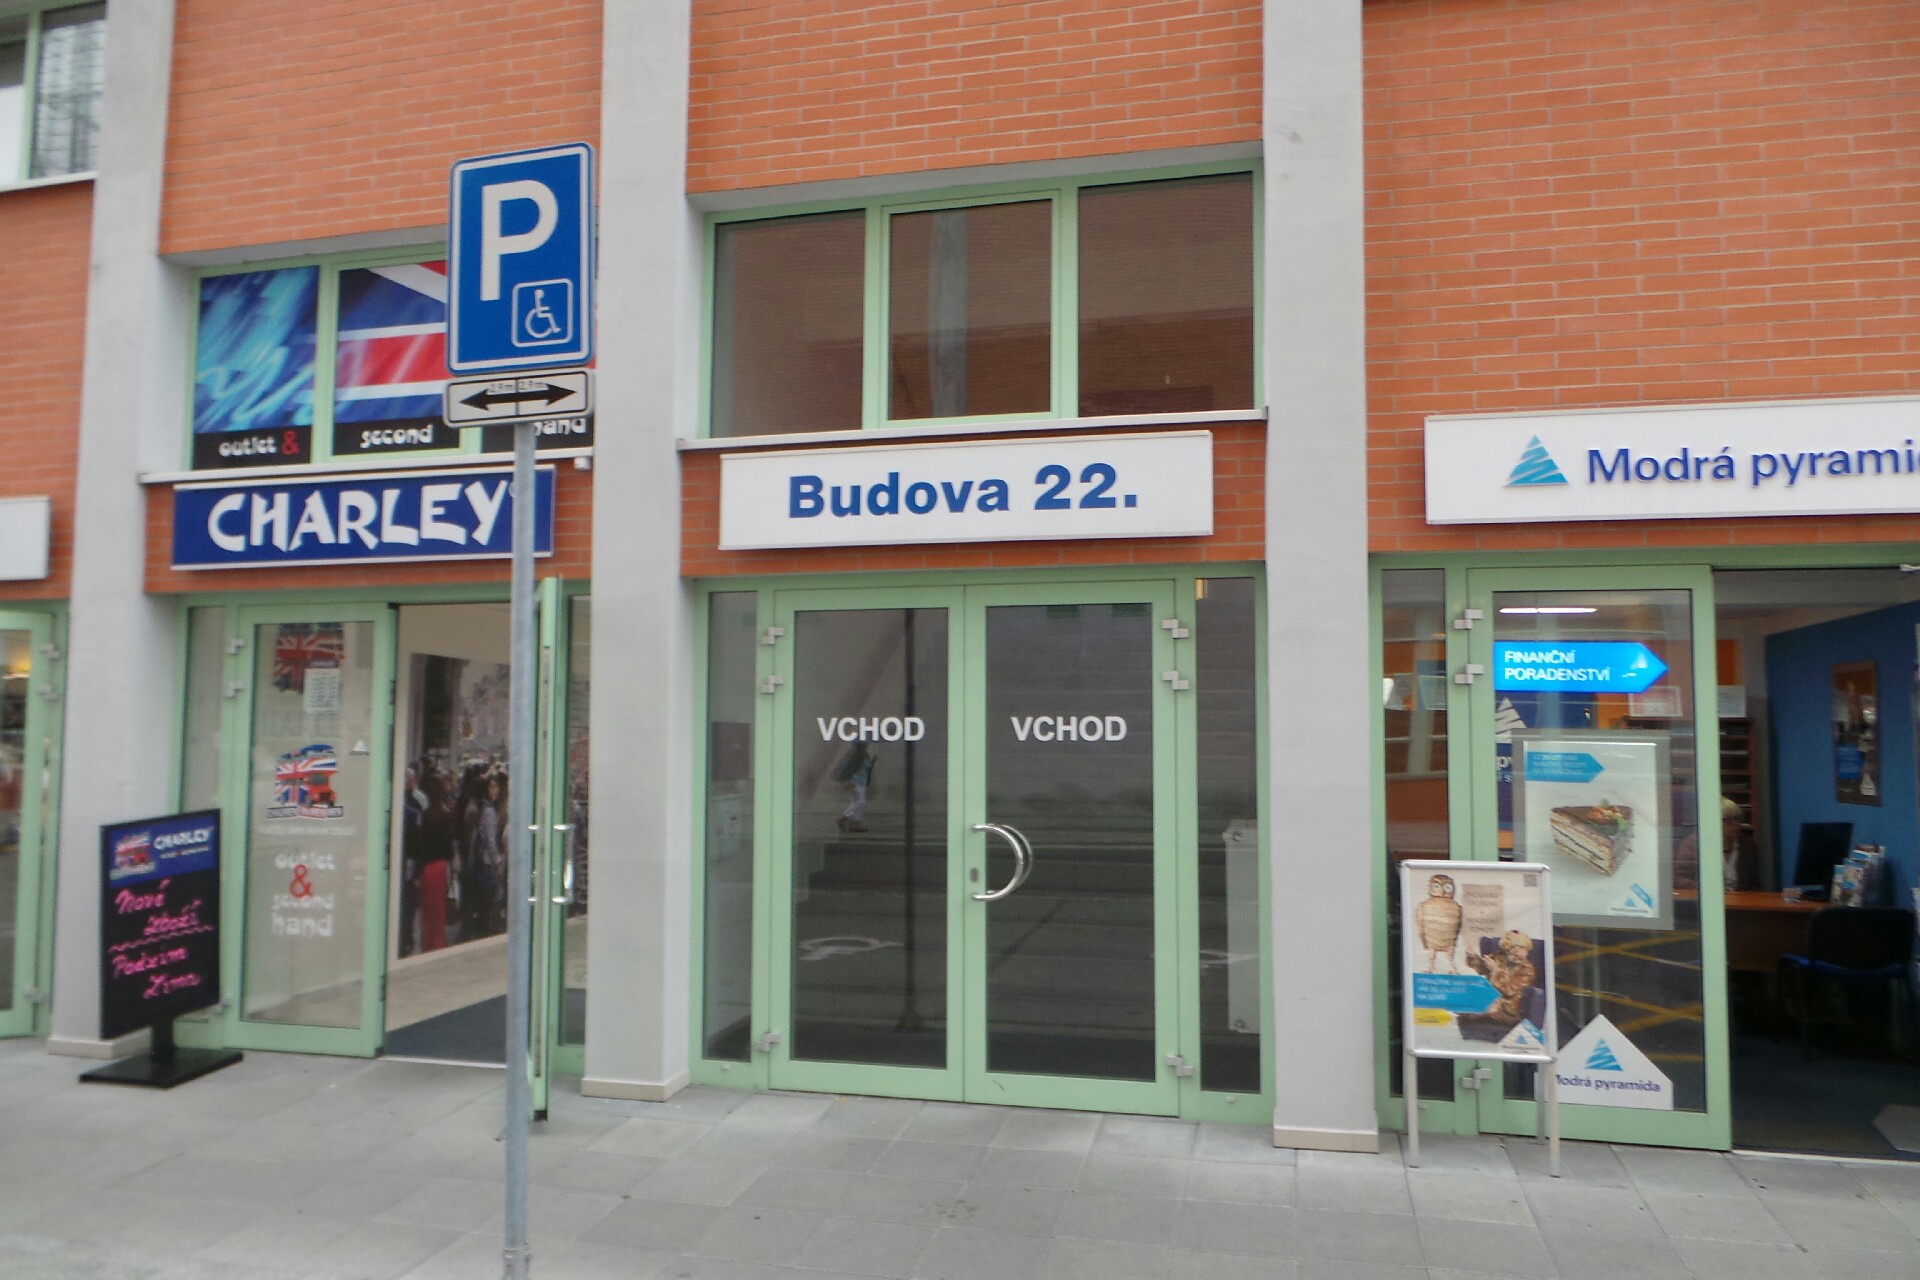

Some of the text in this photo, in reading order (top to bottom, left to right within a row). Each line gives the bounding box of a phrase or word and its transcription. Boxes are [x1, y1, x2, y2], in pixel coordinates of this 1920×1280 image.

[480, 179, 559, 301] P
[218, 418, 587, 457] outlet & second and
[1587, 438, 1920, 488] Modrá pyrami
[788, 462, 1138, 519] Budova 22.
[207, 480, 510, 552] CHARLEY
[1504, 649, 1577, 664] FINANČNÍ
[1504, 667, 1611, 682] PORADENSTVÍ
[816, 716, 926, 742] VCHOD
[1010, 715, 1128, 742] VCHOD
[1594, 1079, 1661, 1092] pyramida
